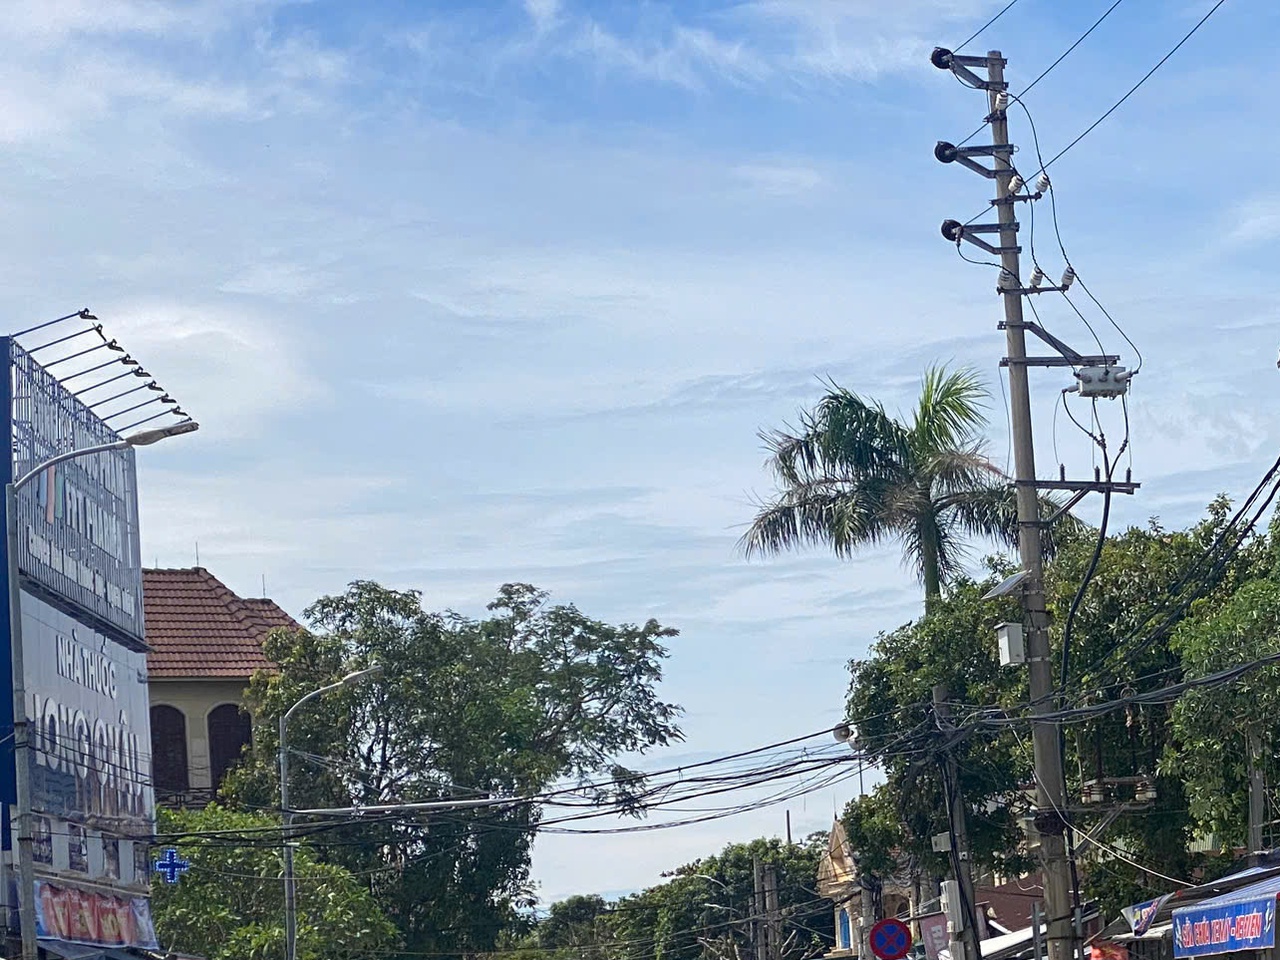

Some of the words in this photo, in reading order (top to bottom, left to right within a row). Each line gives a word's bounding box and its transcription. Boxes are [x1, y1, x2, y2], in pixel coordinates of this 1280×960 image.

[56, 629, 81, 684] NHÀ
[81, 636, 117, 700] THUỐC
[33, 694, 90, 779] LONG
